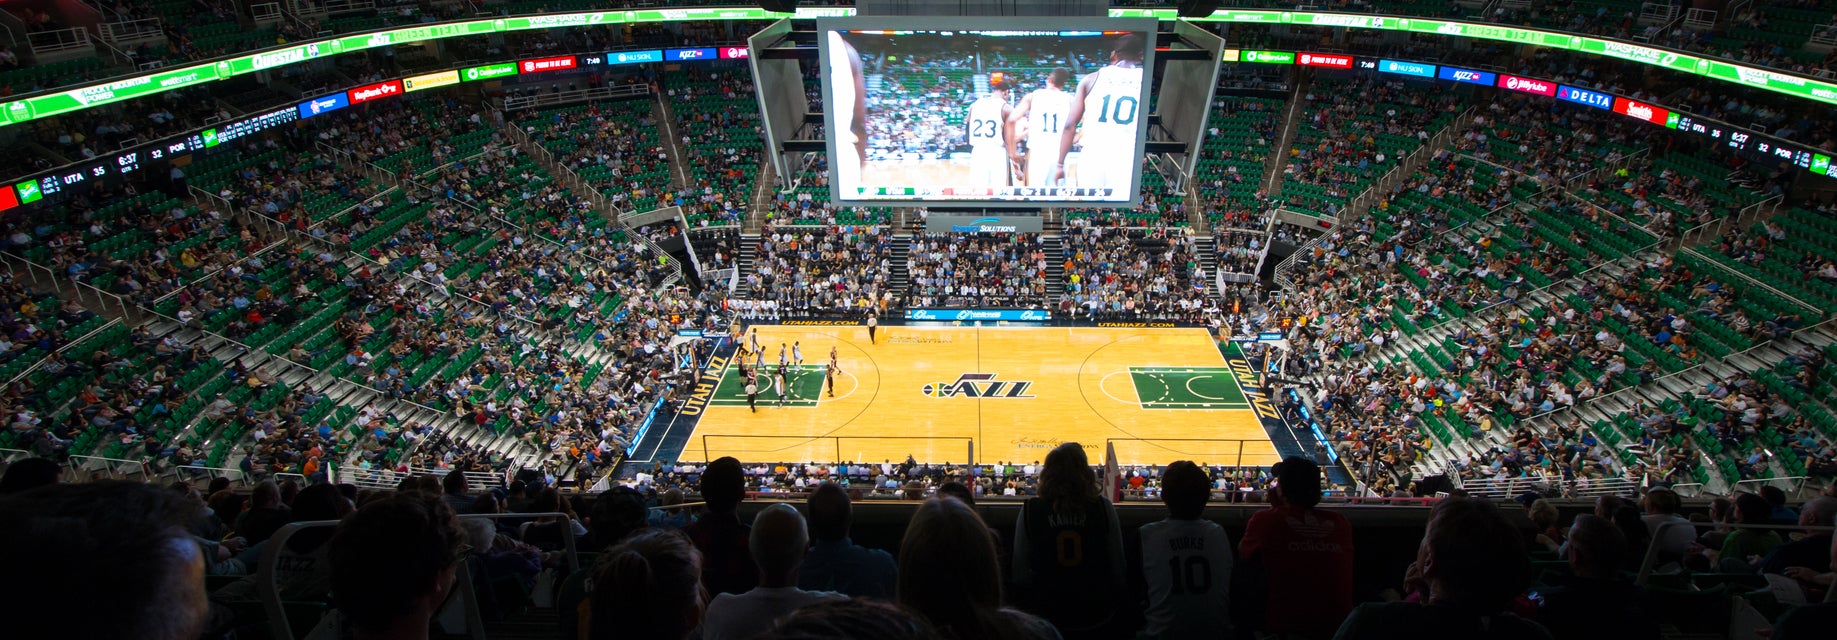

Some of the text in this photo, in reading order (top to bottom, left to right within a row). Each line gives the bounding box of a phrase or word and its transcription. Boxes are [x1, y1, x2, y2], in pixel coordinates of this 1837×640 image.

[528, 15, 586, 25] WASHAKIE
[393, 26, 431, 42] GREEN
[437, 23, 469, 37] TEAM
[1466, 25, 1506, 39] GREEN
[1512, 30, 1544, 44] TEAM
[679, 50, 697, 60] KJZZ
[1258, 53, 1291, 62] CenturyLink
[1605, 42, 1661, 59] WASHAKIE
[252, 49, 305, 71] QUESTAR
[560, 59, 572, 67] HERE
[1325, 57, 1331, 65] TO
[1336, 58, 1348, 66] HERE
[1398, 64, 1408, 72] NU
[479, 66, 513, 77] CenturyLink
[1453, 70, 1474, 81] KJZZ
[84, 76, 152, 97] ROCKY MOUNTAIN
[354, 88, 382, 101] KeyBank
[86, 91, 115, 102] POWER
[1571, 90, 1610, 107] DELTA
[1098, 94, 1138, 125] 10
[972, 119, 997, 138] 23
[1042, 112, 1058, 133] 11
[1692, 124, 1706, 133] UTA
[1711, 129, 1721, 138] 35
[1731, 132, 1749, 143] 6:37
[1758, 143, 1769, 153] 32
[1775, 148, 1792, 159] POR
[64, 173, 84, 184] UTA
[93, 166, 105, 176] 35
[118, 153, 137, 166] 6:37
[151, 150, 162, 160] 32
[169, 142, 186, 154] POR
[980, 225, 1017, 233] SOLUTIONS
[1229, 359, 1261, 388] UTAH
[681, 356, 729, 415] UTAH JAZZ
[922, 373, 1037, 398] JAZZ
[1242, 390, 1280, 419] JAZZ
[1055, 529, 1083, 567] 0
[1168, 537, 1205, 551] BURKS
[1287, 540, 1341, 553] adidas
[276, 556, 316, 571] JAZZ
[1168, 556, 1211, 594] 10
